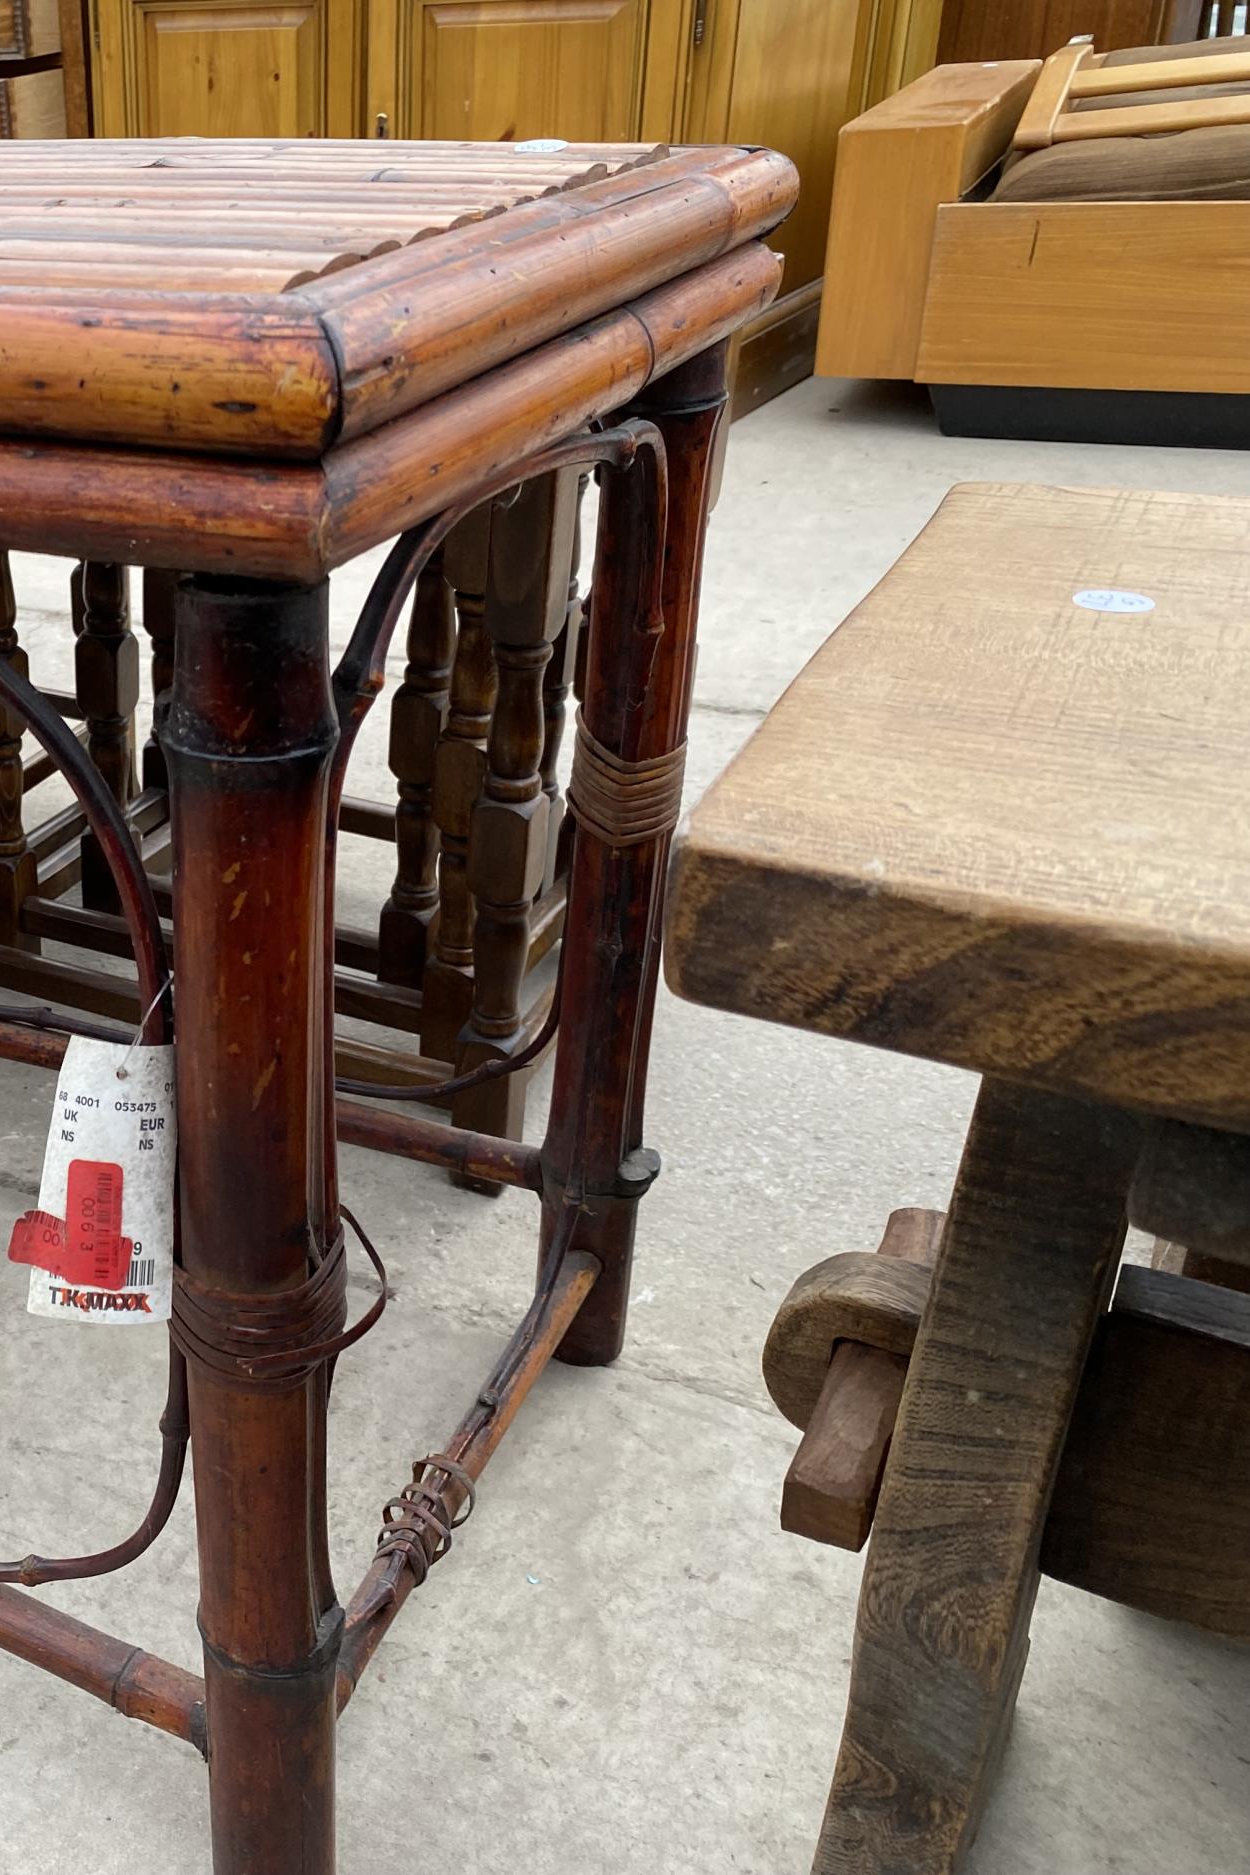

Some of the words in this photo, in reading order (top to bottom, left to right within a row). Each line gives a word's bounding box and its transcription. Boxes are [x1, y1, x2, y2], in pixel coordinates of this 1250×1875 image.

[75, 1096, 100, 1108] 4001
[114, 1102, 156, 1112] 053475
[64, 1109, 78, 1122] UK
[140, 1118, 165, 1131] EUR
[61, 1130, 75, 1142] NS
[139, 1139, 154, 1151] NS
